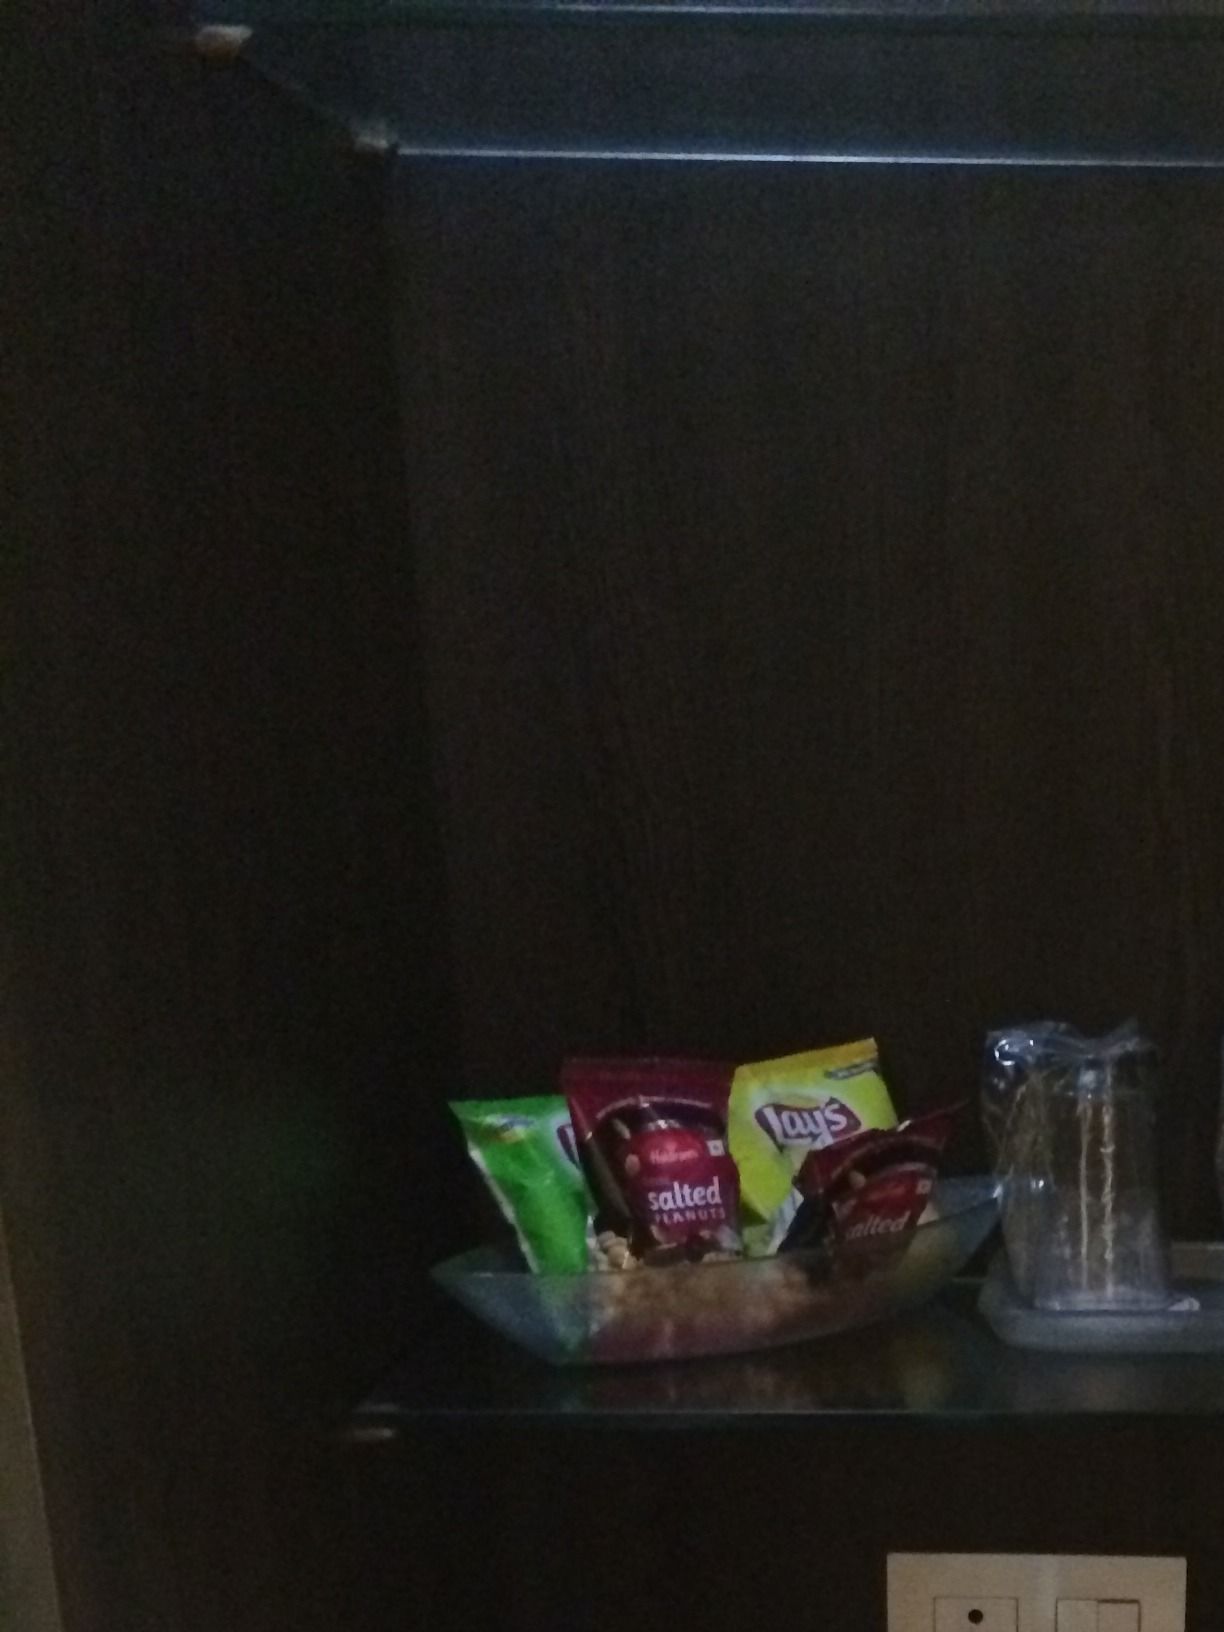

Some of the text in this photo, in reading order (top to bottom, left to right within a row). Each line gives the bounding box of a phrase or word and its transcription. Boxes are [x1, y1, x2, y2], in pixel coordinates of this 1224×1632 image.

[647, 1175, 722, 1212] salted
[654, 1206, 726, 1226] PEANUTS
[845, 1210, 912, 1240] alted
